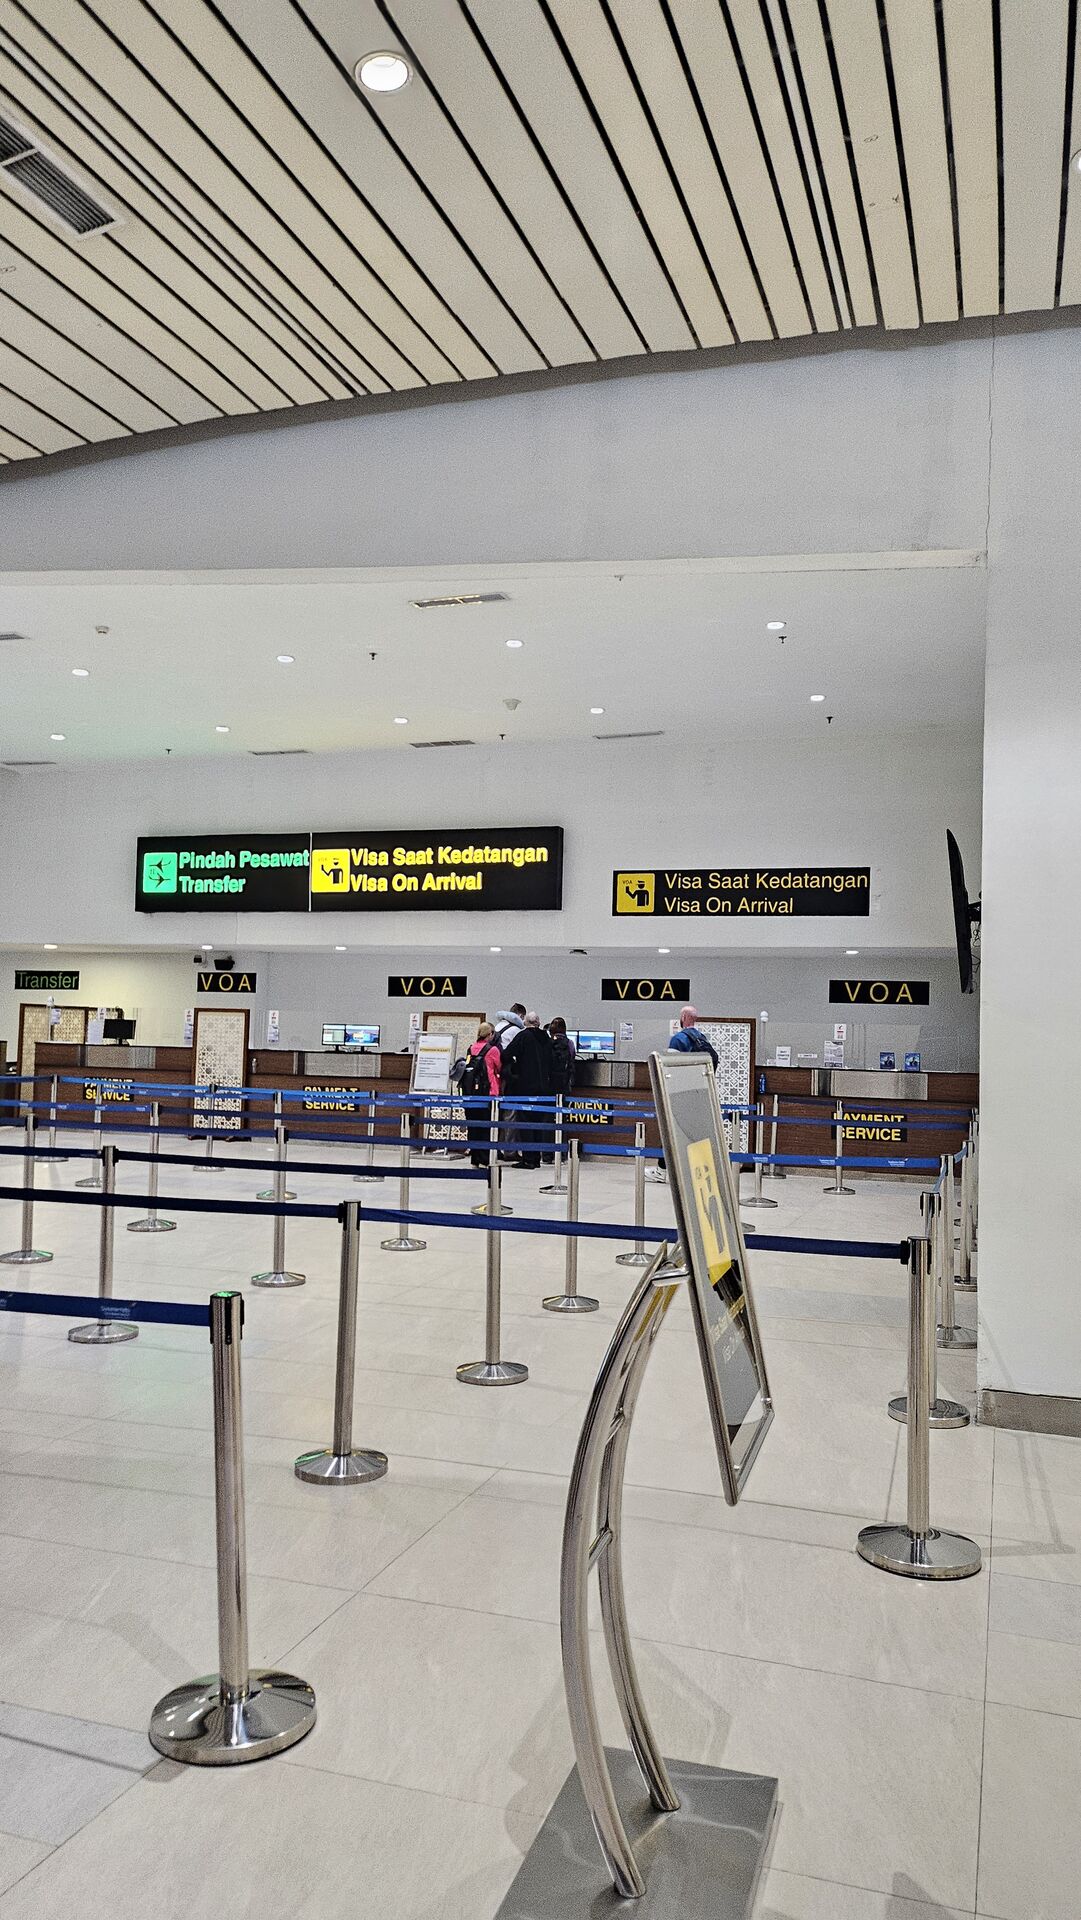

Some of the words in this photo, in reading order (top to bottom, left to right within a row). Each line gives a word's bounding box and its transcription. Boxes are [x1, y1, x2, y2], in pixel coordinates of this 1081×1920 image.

[178, 850, 236, 869] Pindah
[239, 847, 310, 869] Pesawat
[350, 847, 389, 867] Visa
[392, 847, 434, 867] Saat
[437, 845, 549, 867] Kedatangan
[178, 874, 247, 894] Transfer
[350, 872, 389, 892] Visa
[391, 872, 419, 892] On
[421, 871, 483, 892] Arrival
[664, 872, 703, 889] Visa
[708, 872, 750, 889] Saat
[755, 872, 869, 893] Kedatangan
[664, 896, 701, 913] Visa
[706, 896, 732, 913] On
[736, 896, 794, 914] Arrival
[16, 971, 79, 989] Transfer
[200, 973, 252, 991] VOA
[400, 977, 456, 996] VOA
[615, 980, 676, 999] VOA
[844, 982, 914, 1003] VOA
[84, 1077, 133, 1090] PAMENT
[305, 1099, 355, 1111] SERVICE
[566, 1112, 608, 1124] RVICE
